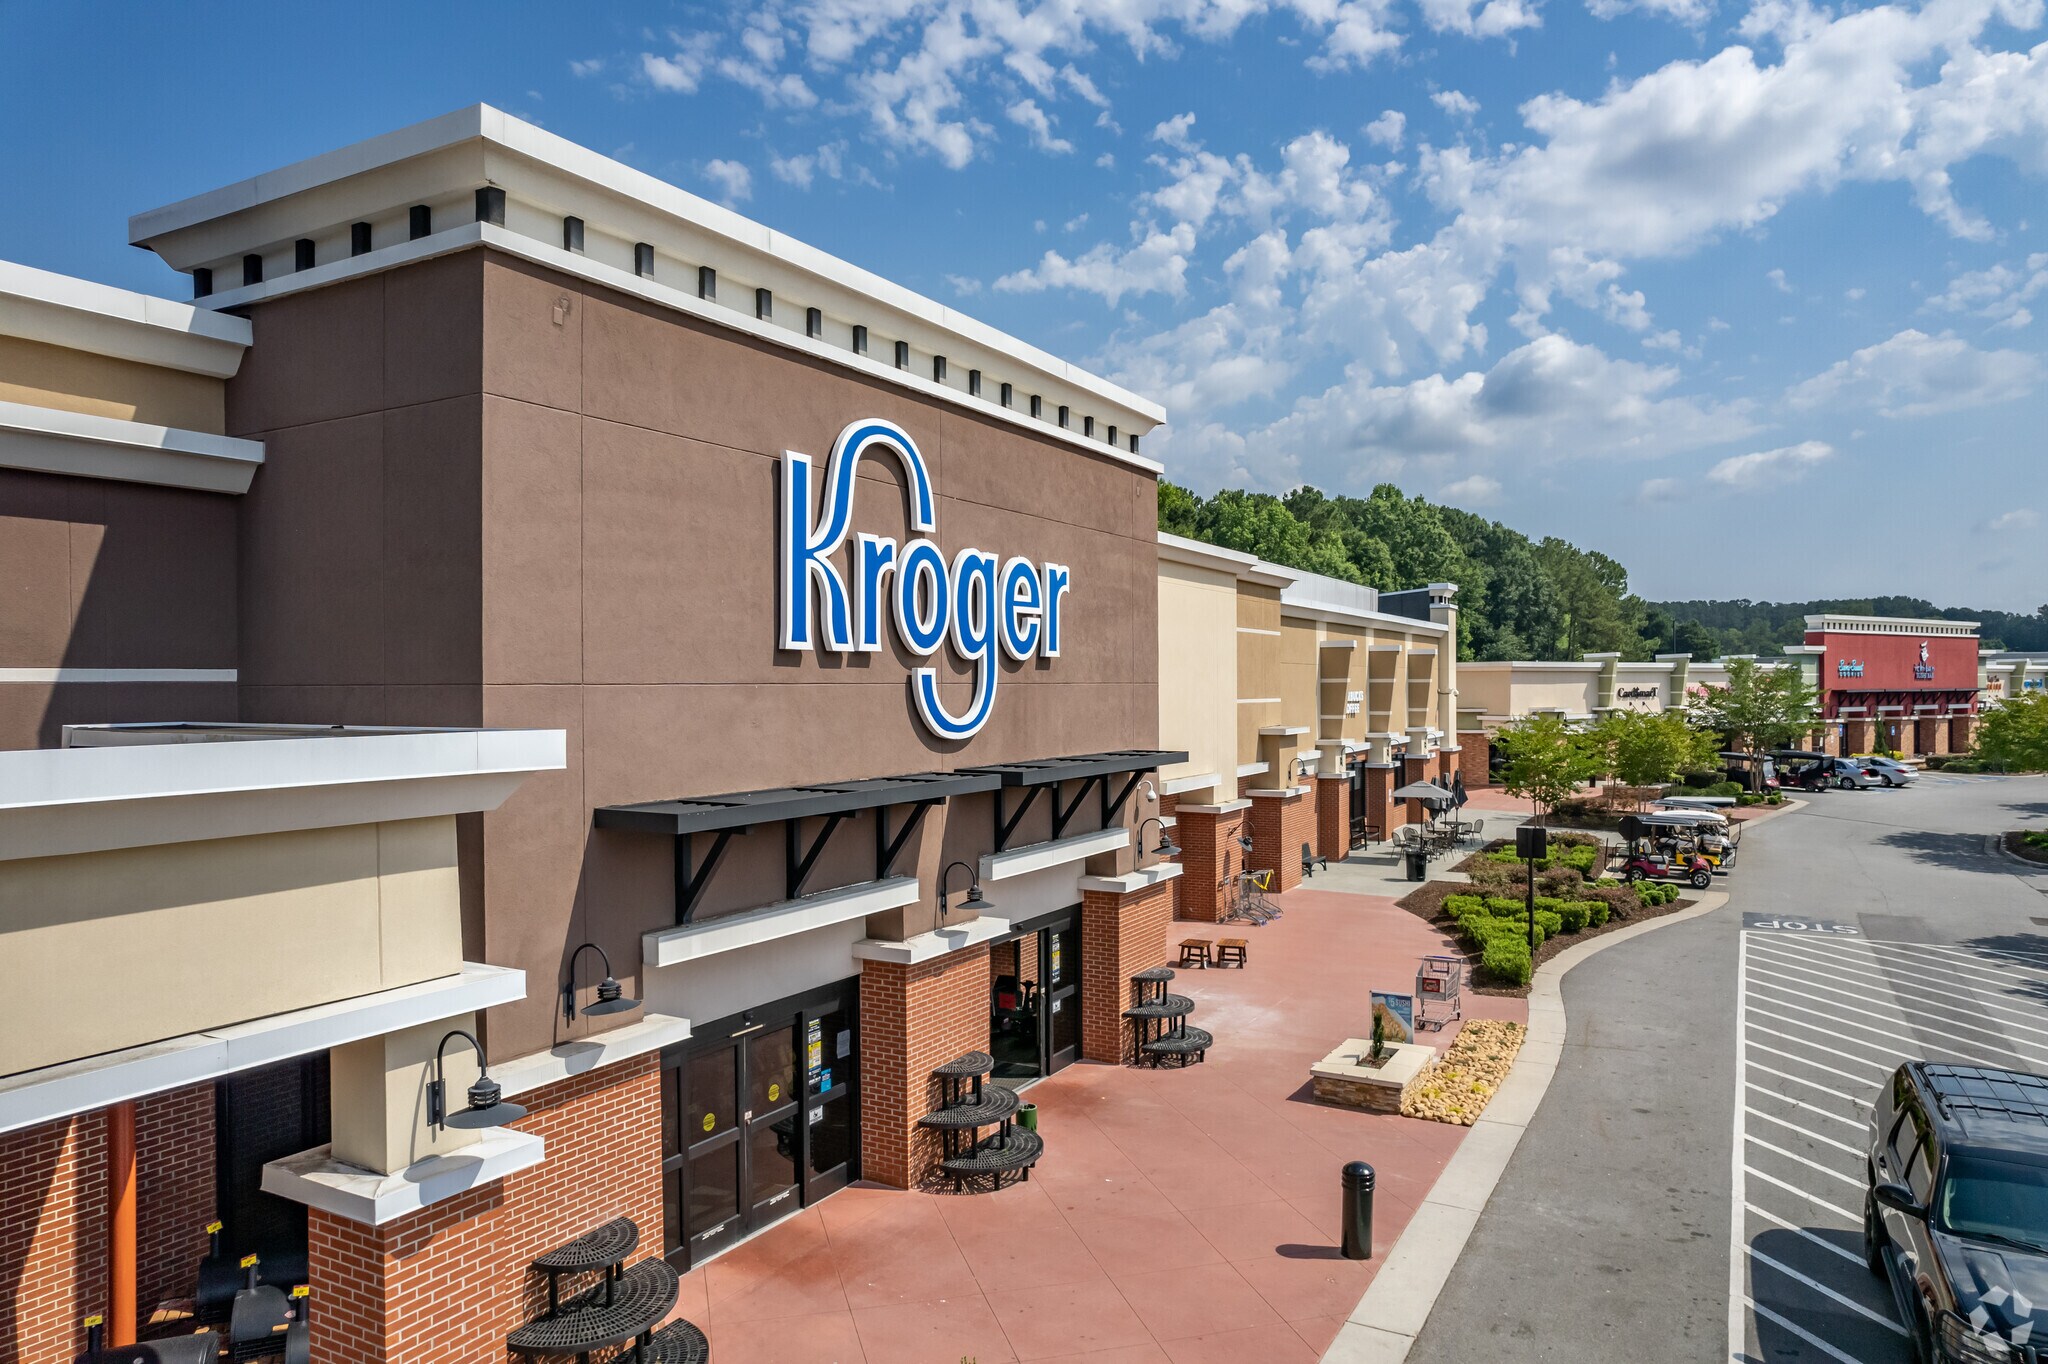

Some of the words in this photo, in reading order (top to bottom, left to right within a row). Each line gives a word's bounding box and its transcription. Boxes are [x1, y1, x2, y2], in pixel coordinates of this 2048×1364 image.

[780, 418, 1069, 739] Kroger
[1346, 703, 1360, 713] OFFEE
[1753, 920, 1858, 934] STOP
